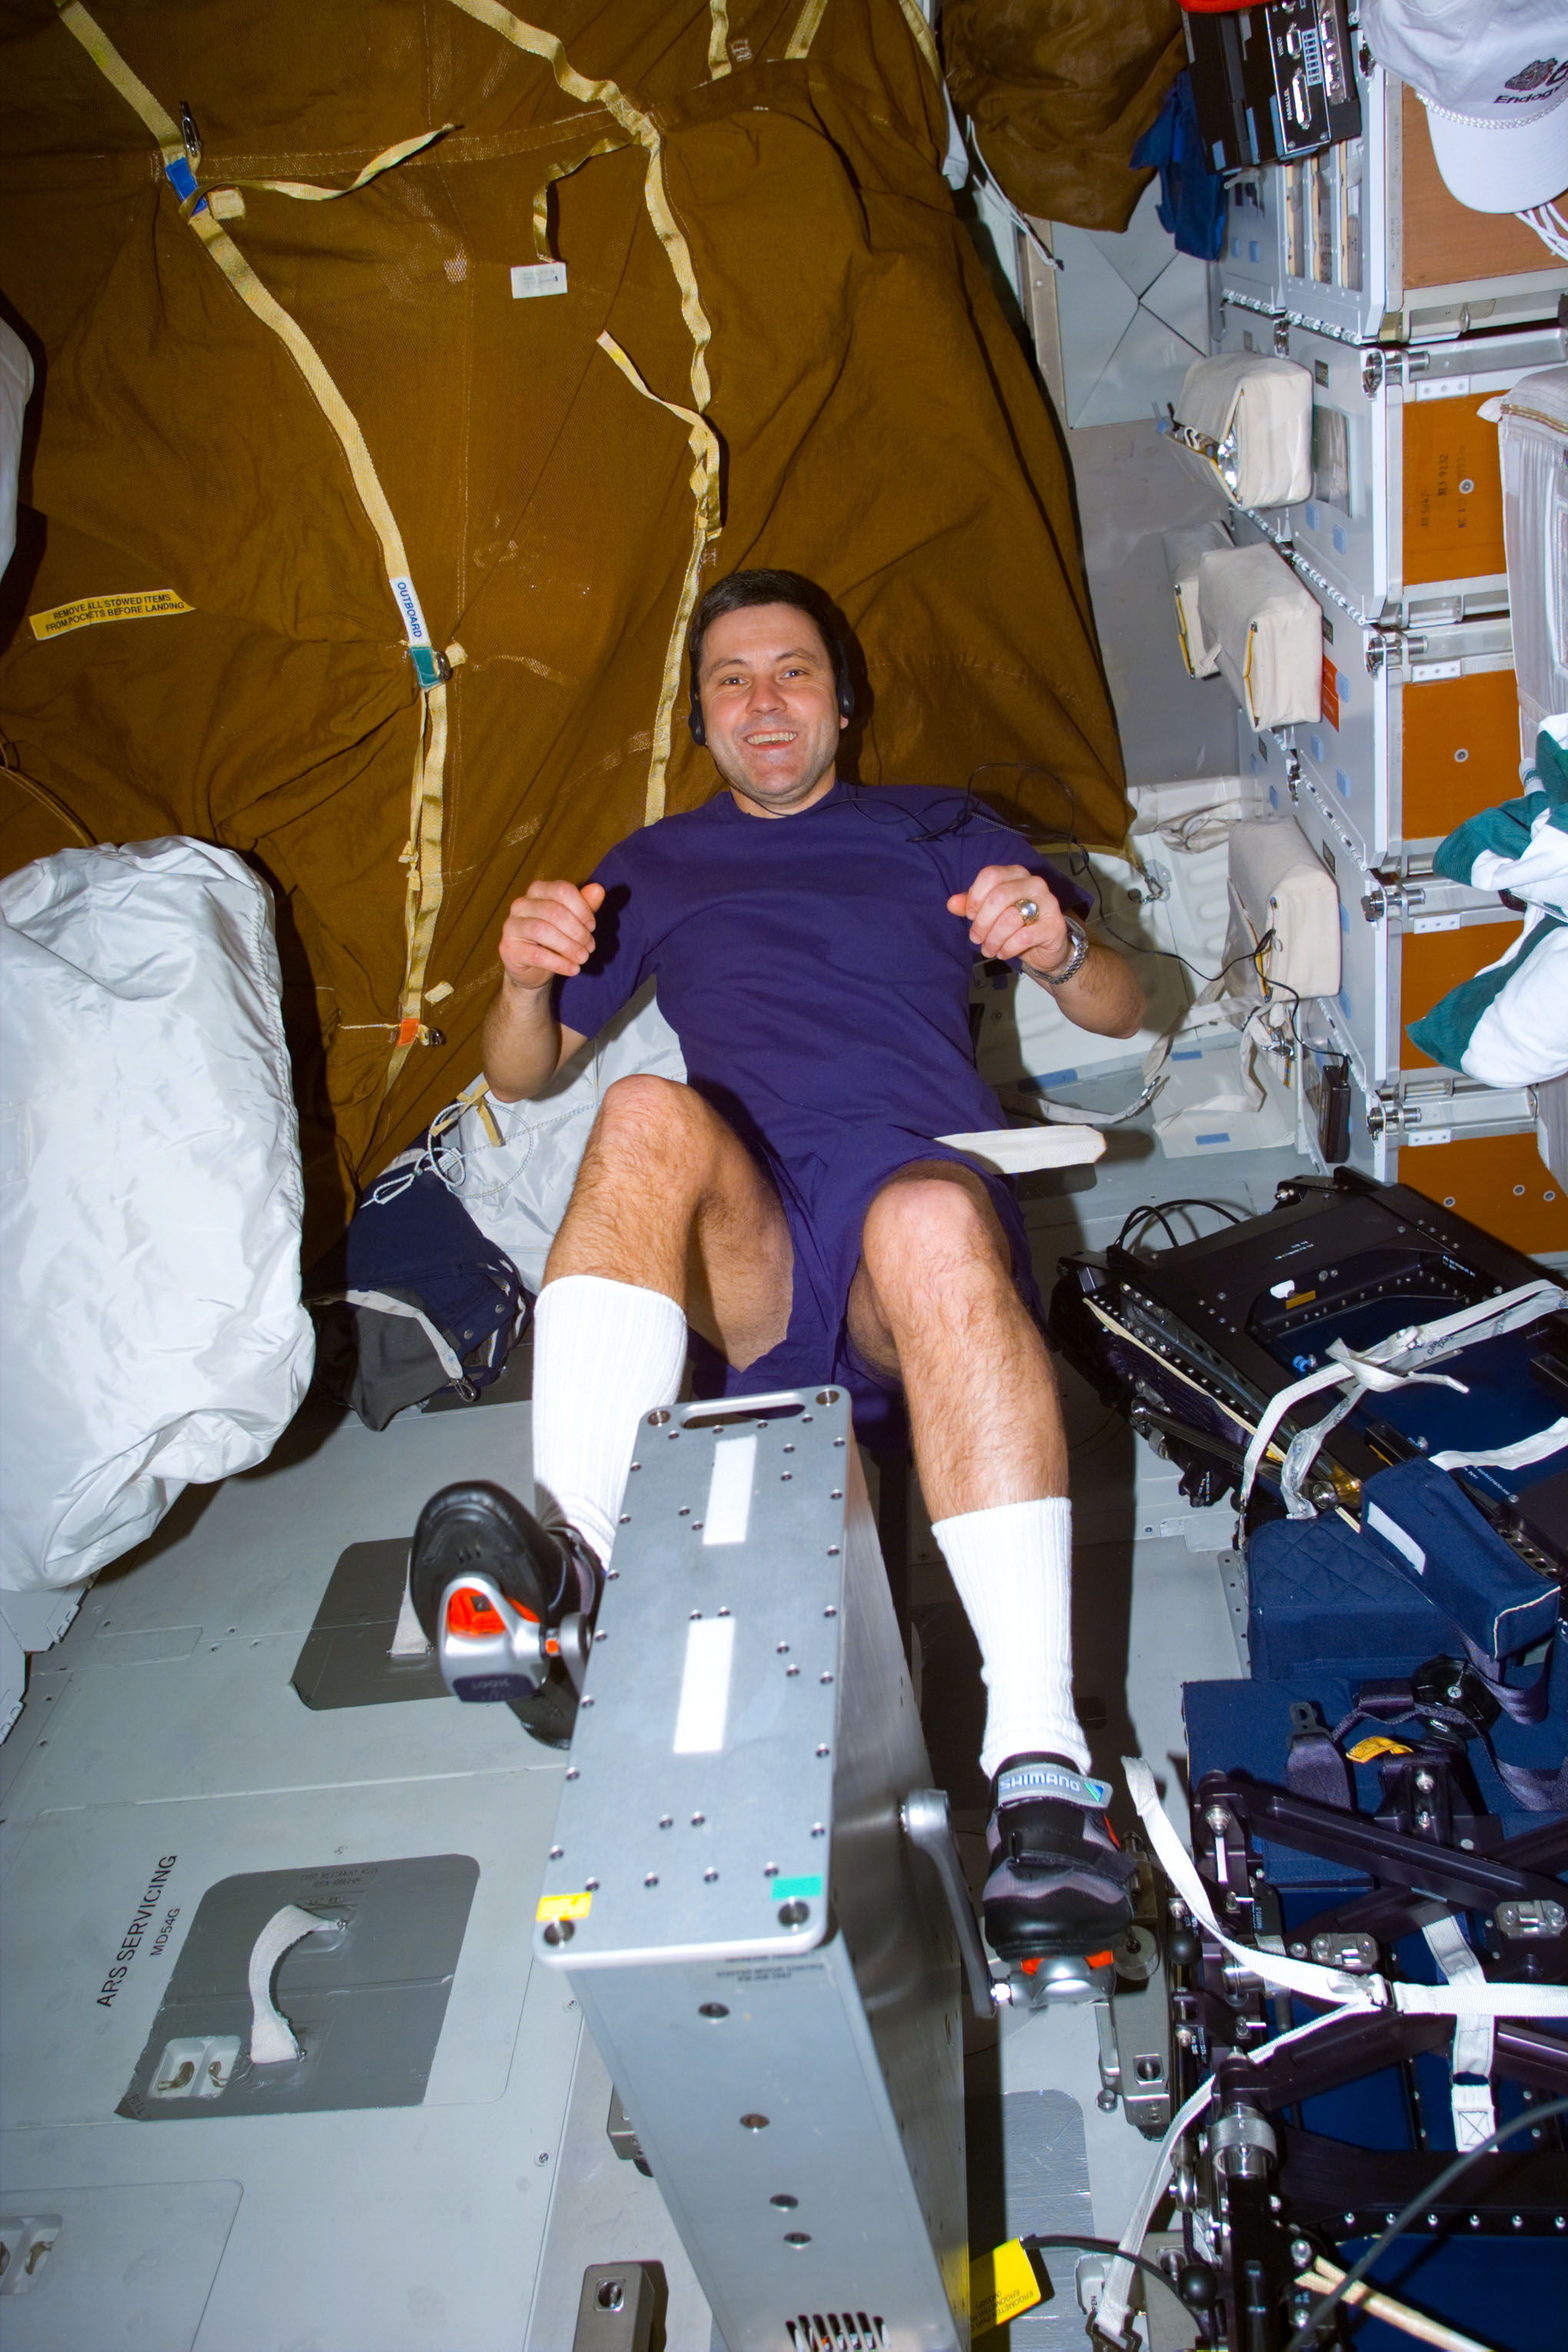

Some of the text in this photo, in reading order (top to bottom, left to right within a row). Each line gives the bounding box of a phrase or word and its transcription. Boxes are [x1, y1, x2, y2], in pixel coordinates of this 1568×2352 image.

[1276, 36, 1284, 57] VIDEO
[1284, 88, 1293, 121] PARALLEL
[45, 601, 185, 633] FROM POCKETS BEFORE LANDING
[53, 593, 171, 620] REMOVE ALL STOWED ITEMS
[397, 582, 422, 638] OUTBOARD
[999, 1772, 1081, 1792] SHIMANO
[321, 1869, 358, 1879] RESTRAINT
[97, 1854, 178, 2008] ARS SERVICING
